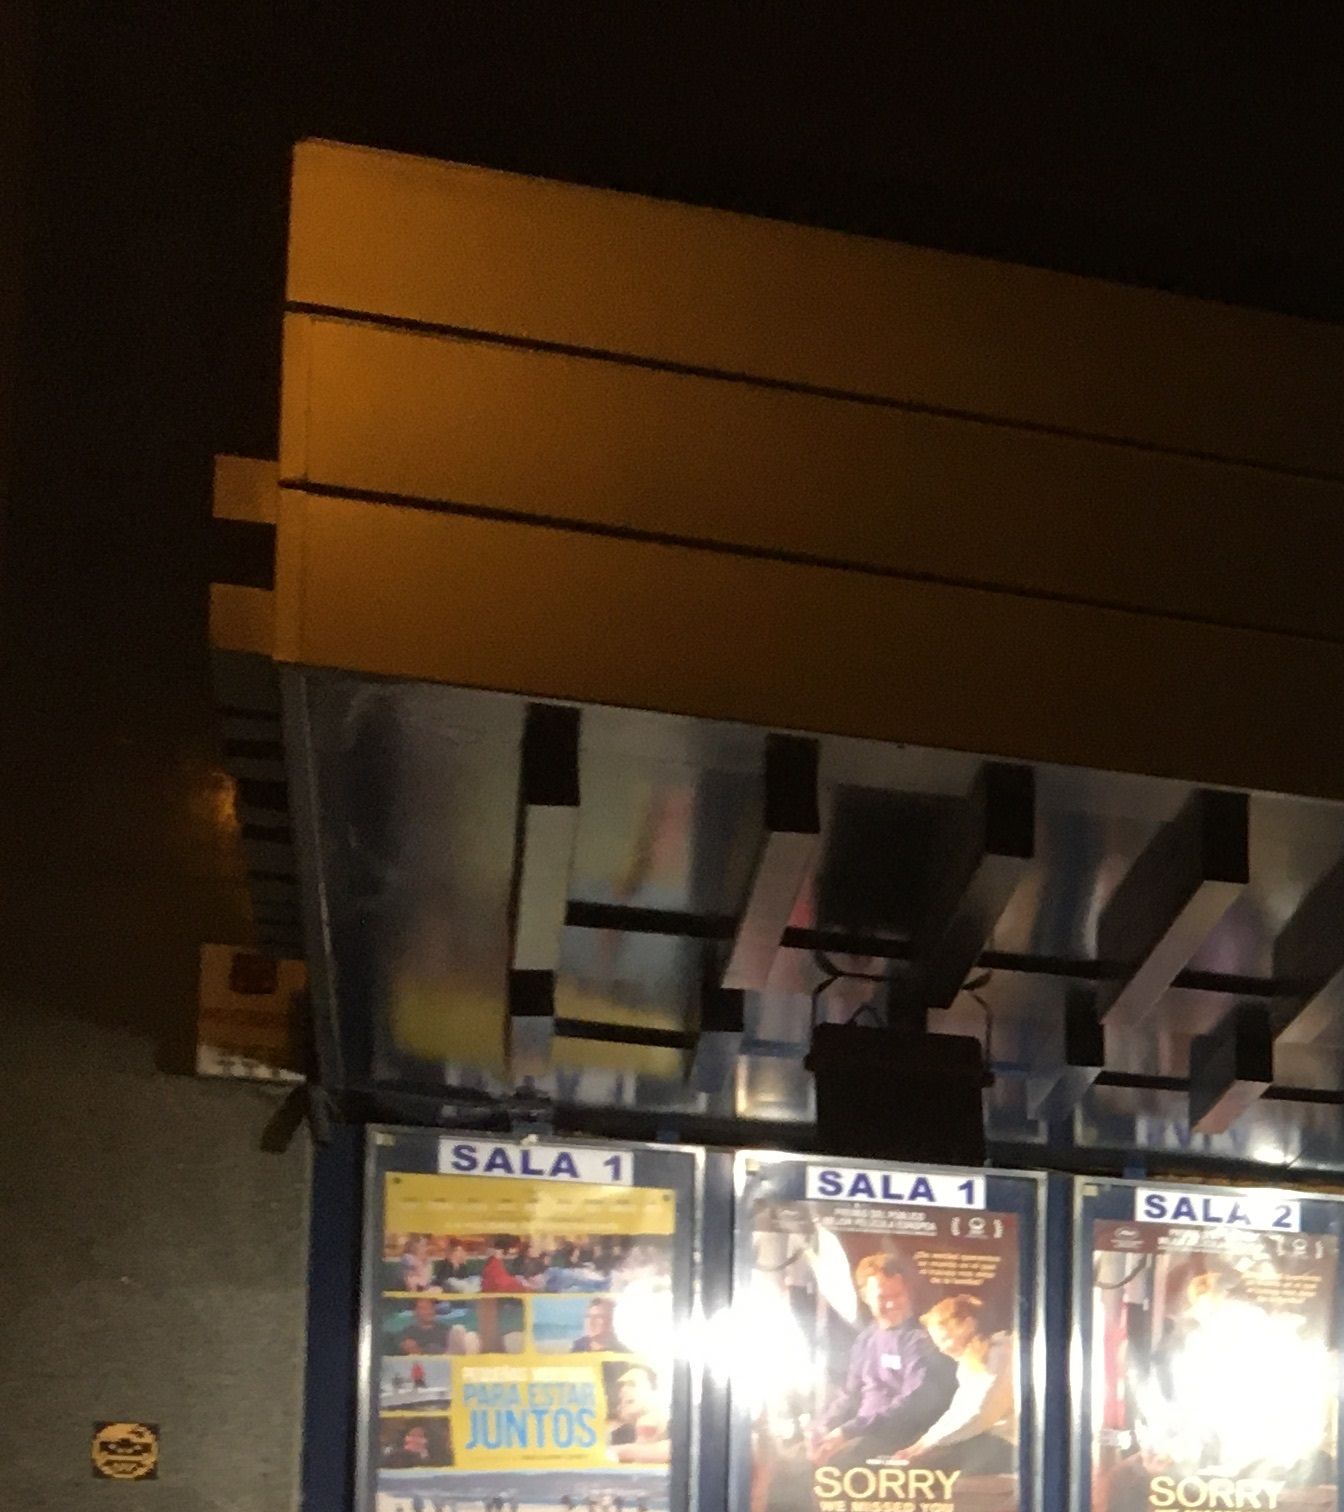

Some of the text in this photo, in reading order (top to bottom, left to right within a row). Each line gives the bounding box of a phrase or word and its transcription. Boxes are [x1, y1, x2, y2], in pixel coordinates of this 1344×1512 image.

[451, 1143, 623, 1182] SALA 1
[817, 1169, 976, 1206] SALA 1
[1143, 1193, 1294, 1230] SALA 2
[464, 1407, 597, 1450] JUNTOS
[813, 1466, 961, 1500] SORRY
[1149, 1475, 1286, 1510] SORRY
[819, 1500, 846, 1512] WE
